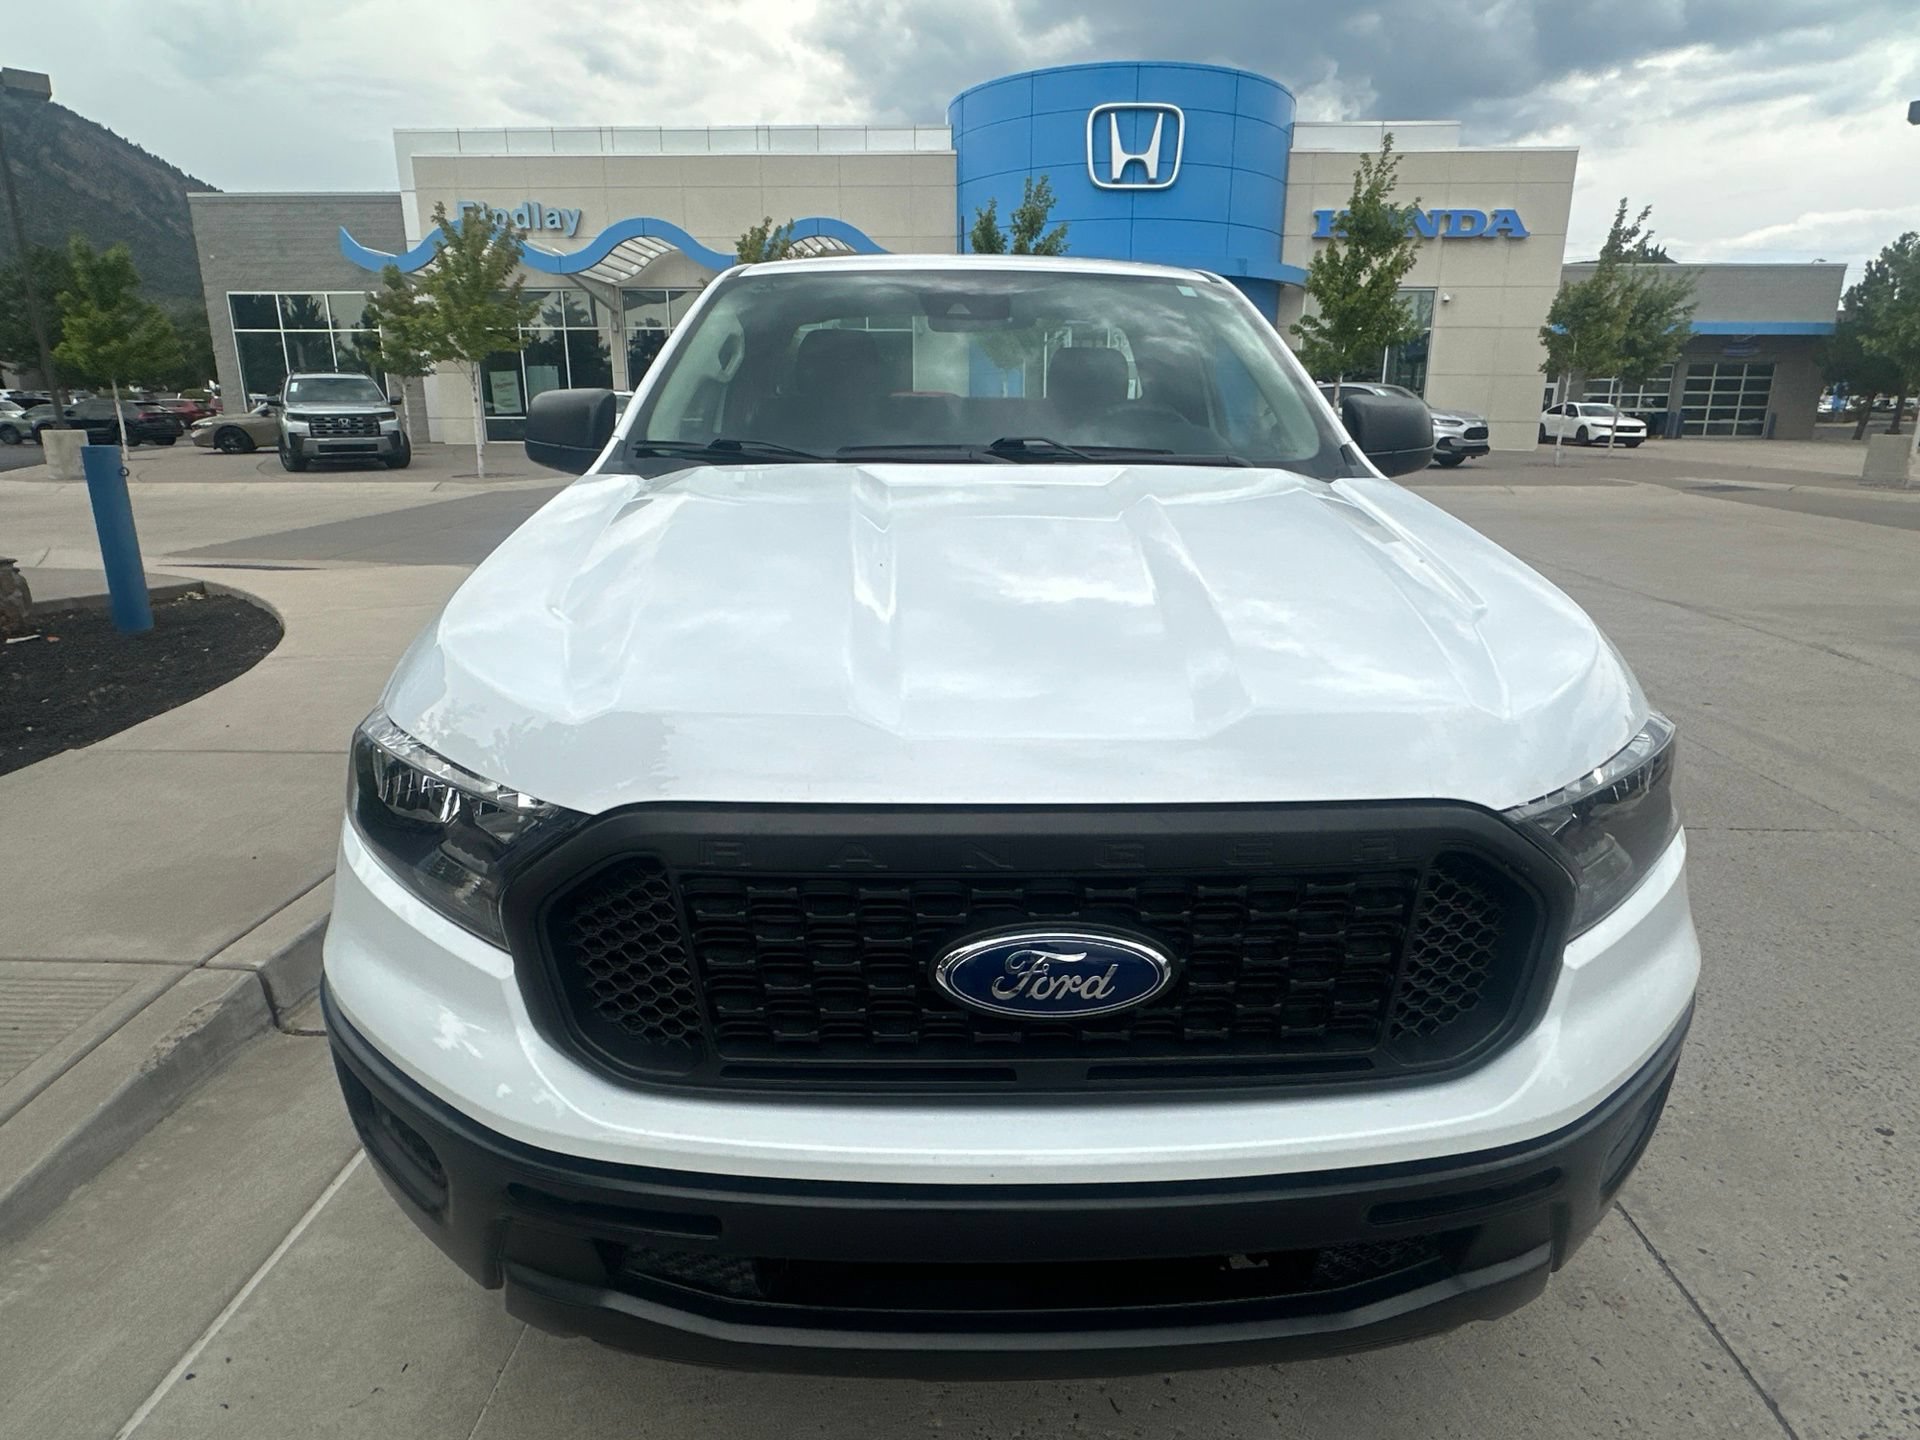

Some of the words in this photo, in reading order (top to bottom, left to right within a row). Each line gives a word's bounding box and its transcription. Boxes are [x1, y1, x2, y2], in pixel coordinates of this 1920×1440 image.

[1312, 208, 1530, 239] HNDA
[697, 837, 1400, 868] RANGER
[991, 949, 1119, 1000] Ford
